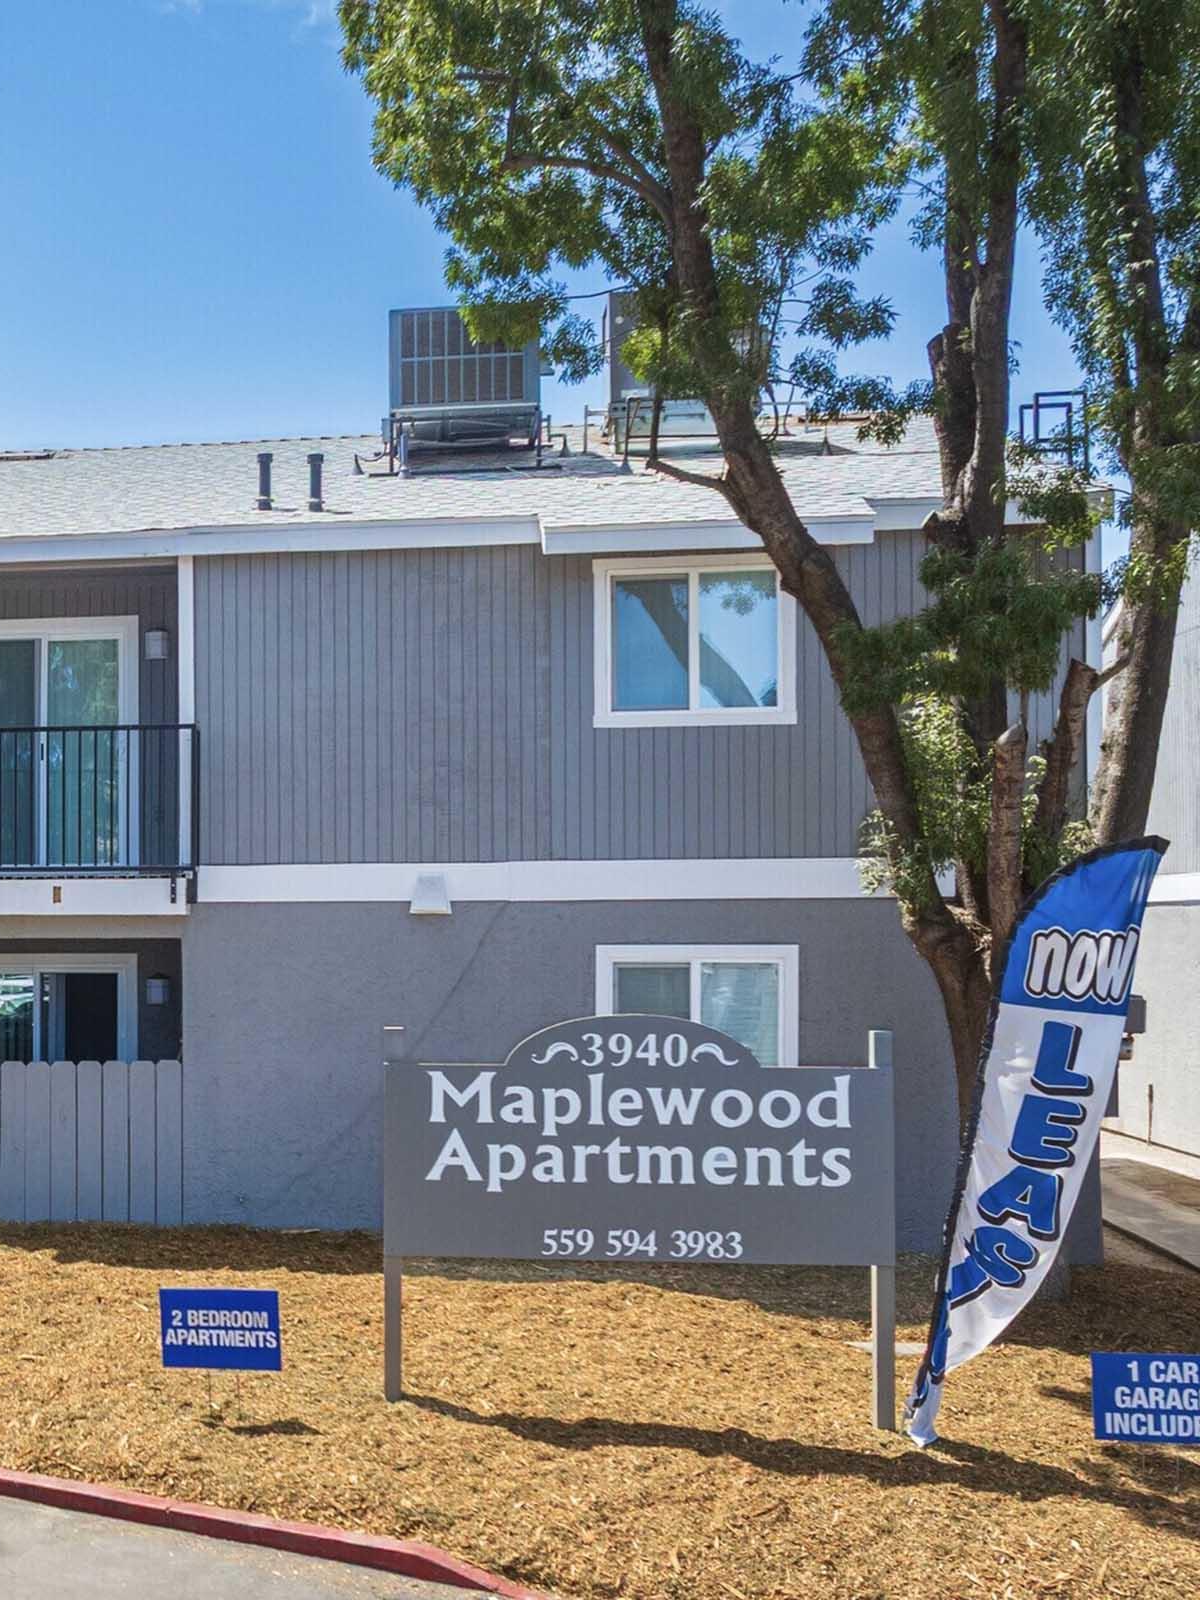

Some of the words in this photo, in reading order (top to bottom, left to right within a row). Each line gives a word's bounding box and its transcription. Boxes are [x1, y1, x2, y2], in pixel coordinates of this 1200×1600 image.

[580, 1033, 688, 1068] 3940
[426, 1070, 852, 1137] Maplewood
[425, 1127, 853, 1193] Apartments
[541, 1228, 595, 1256] 559
[605, 1229, 658, 1257] 594
[670, 1230, 744, 1259] 3983
[171, 1310, 183, 1327] 2
[187, 1309, 269, 1328] BEDROOM
[165, 1328, 278, 1349] APARTMENTS
[1126, 1360, 1139, 1382] 1
[1149, 1360, 1200, 1384] CAR
[1114, 1386, 1200, 1411] GARAG
